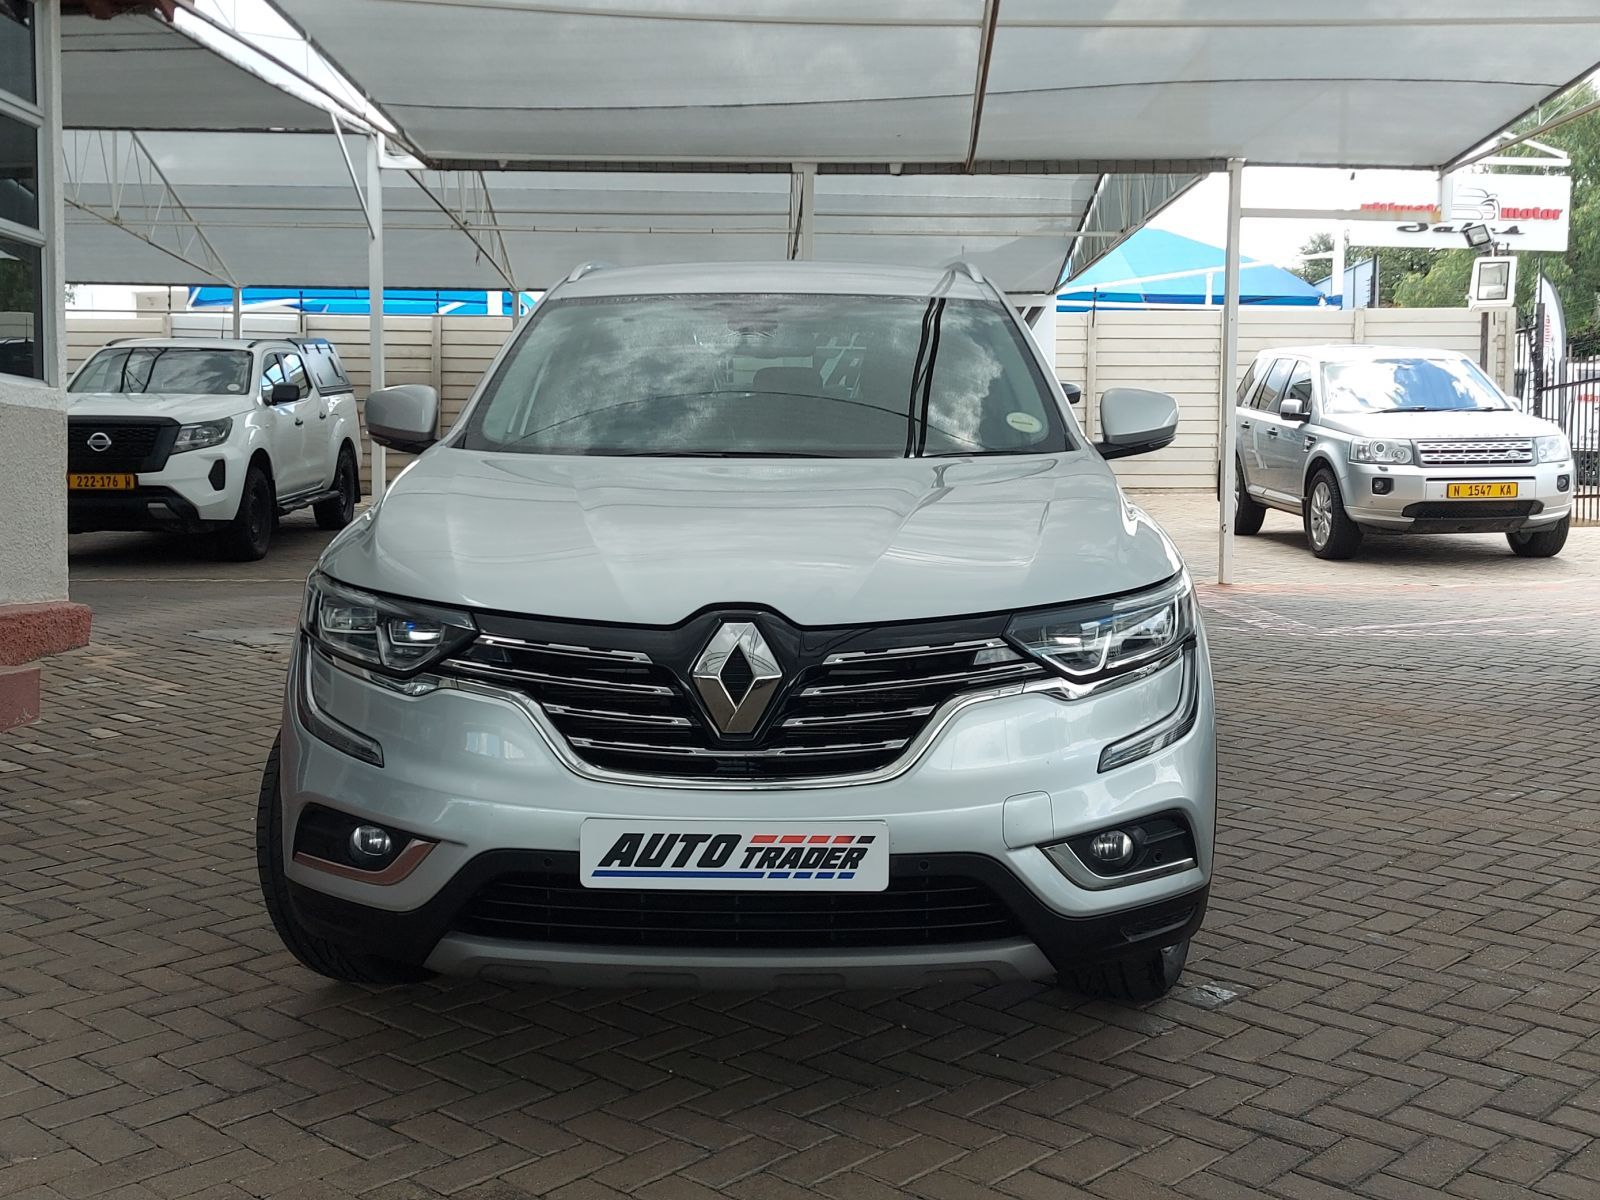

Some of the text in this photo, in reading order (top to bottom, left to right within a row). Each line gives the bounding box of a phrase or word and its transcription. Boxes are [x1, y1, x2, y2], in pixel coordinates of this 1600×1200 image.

[1501, 206, 1563, 221] motor
[77, 475, 118, 488] 222-176
[1453, 484, 1512, 496] N 1547 KA
[597, 833, 869, 870] AUTO TRADER
